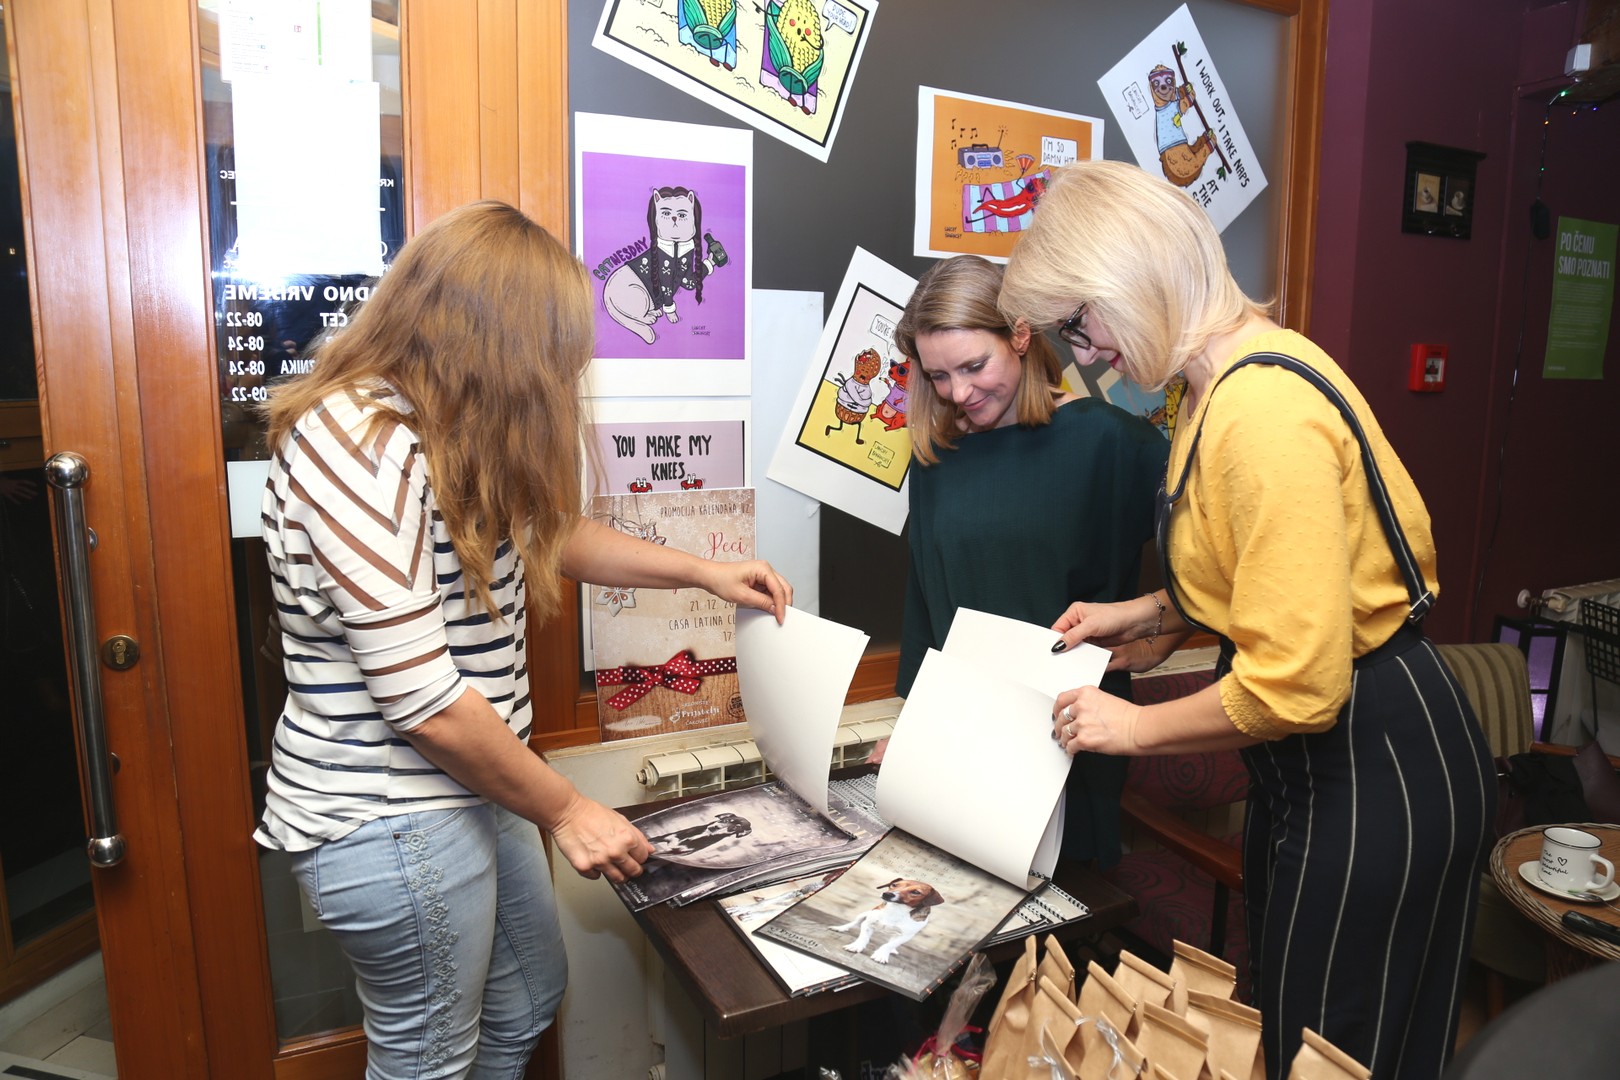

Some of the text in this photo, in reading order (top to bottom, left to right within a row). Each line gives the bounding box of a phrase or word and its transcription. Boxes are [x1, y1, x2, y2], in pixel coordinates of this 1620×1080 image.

[1195, 59, 1250, 188] I WORK OUT, I TAKE NAPS
[1043, 138, 1065, 153] I'M SO
[1043, 152, 1062, 164] DAMN
[1198, 183, 1212, 208] THE
[1206, 179, 1220, 195] AT
[1560, 230, 1595, 255] PO ČEMU
[592, 236, 649, 281] CATNESDAY
[1558, 255, 1610, 279] SMO POZNATI
[612, 434, 712, 458] YOU MAKE MY
[651, 461, 686, 481] KNEES
[661, 504, 696, 519] PROMOCIJA
[699, 502, 737, 516] KALENDARA
[704, 531, 748, 561] Peci
[669, 613, 736, 631] CASA LATINA CL
